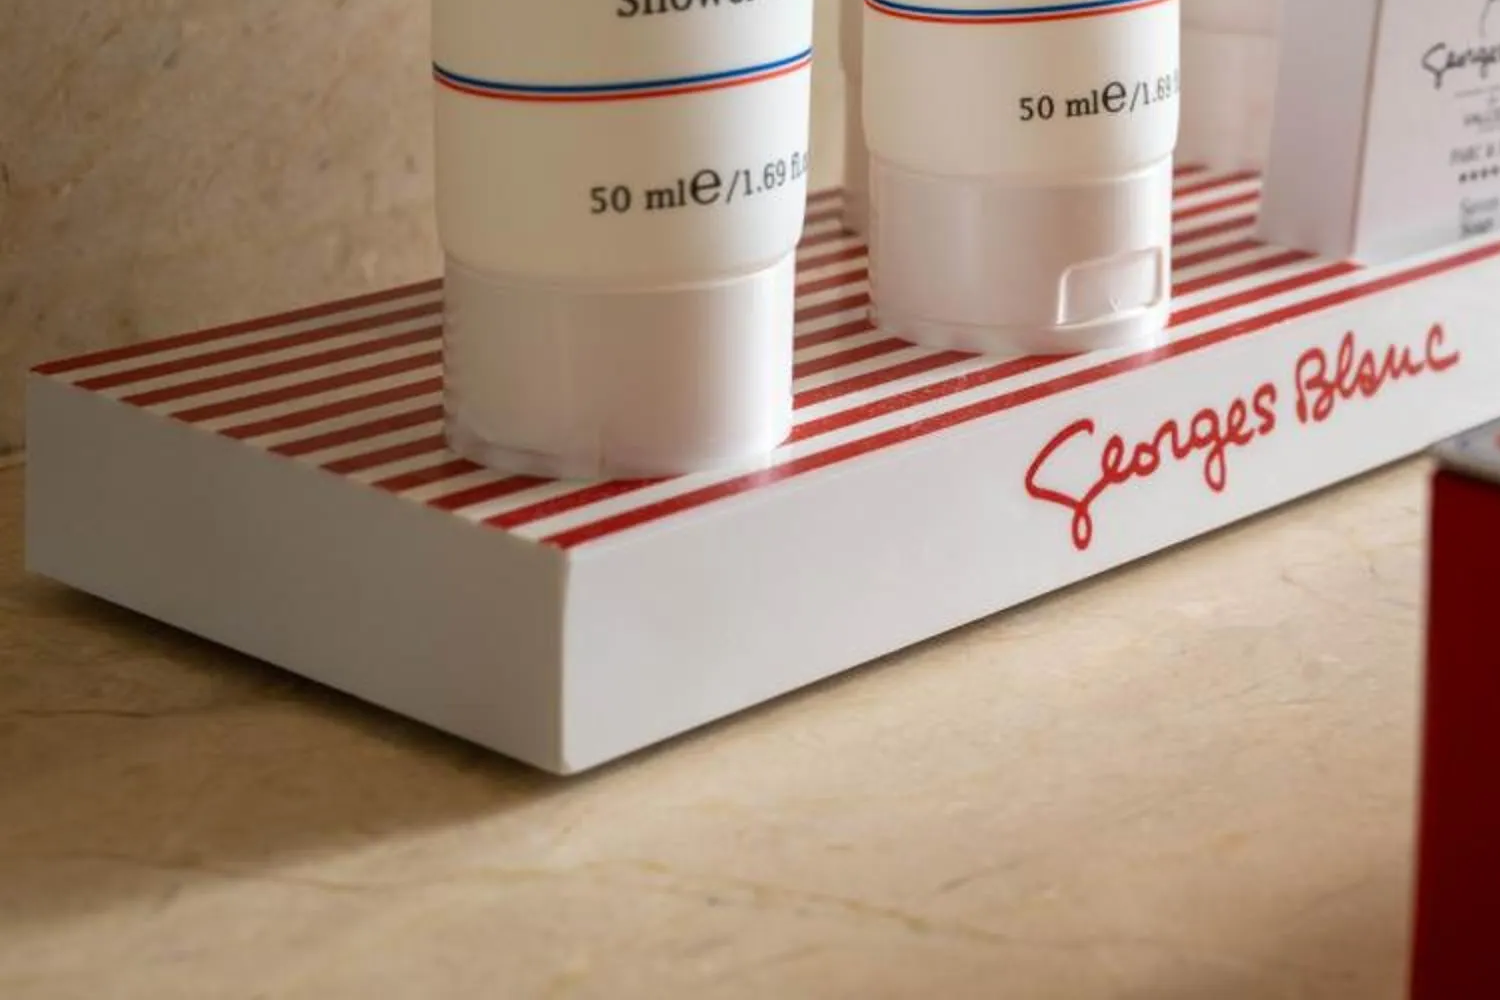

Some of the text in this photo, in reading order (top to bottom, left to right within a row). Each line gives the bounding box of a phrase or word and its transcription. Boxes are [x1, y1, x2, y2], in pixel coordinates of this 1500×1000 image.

[1019, 95, 1055, 121] 50
[590, 184, 632, 214] 50
[1024, 322, 1460, 551] Georges Blanc
